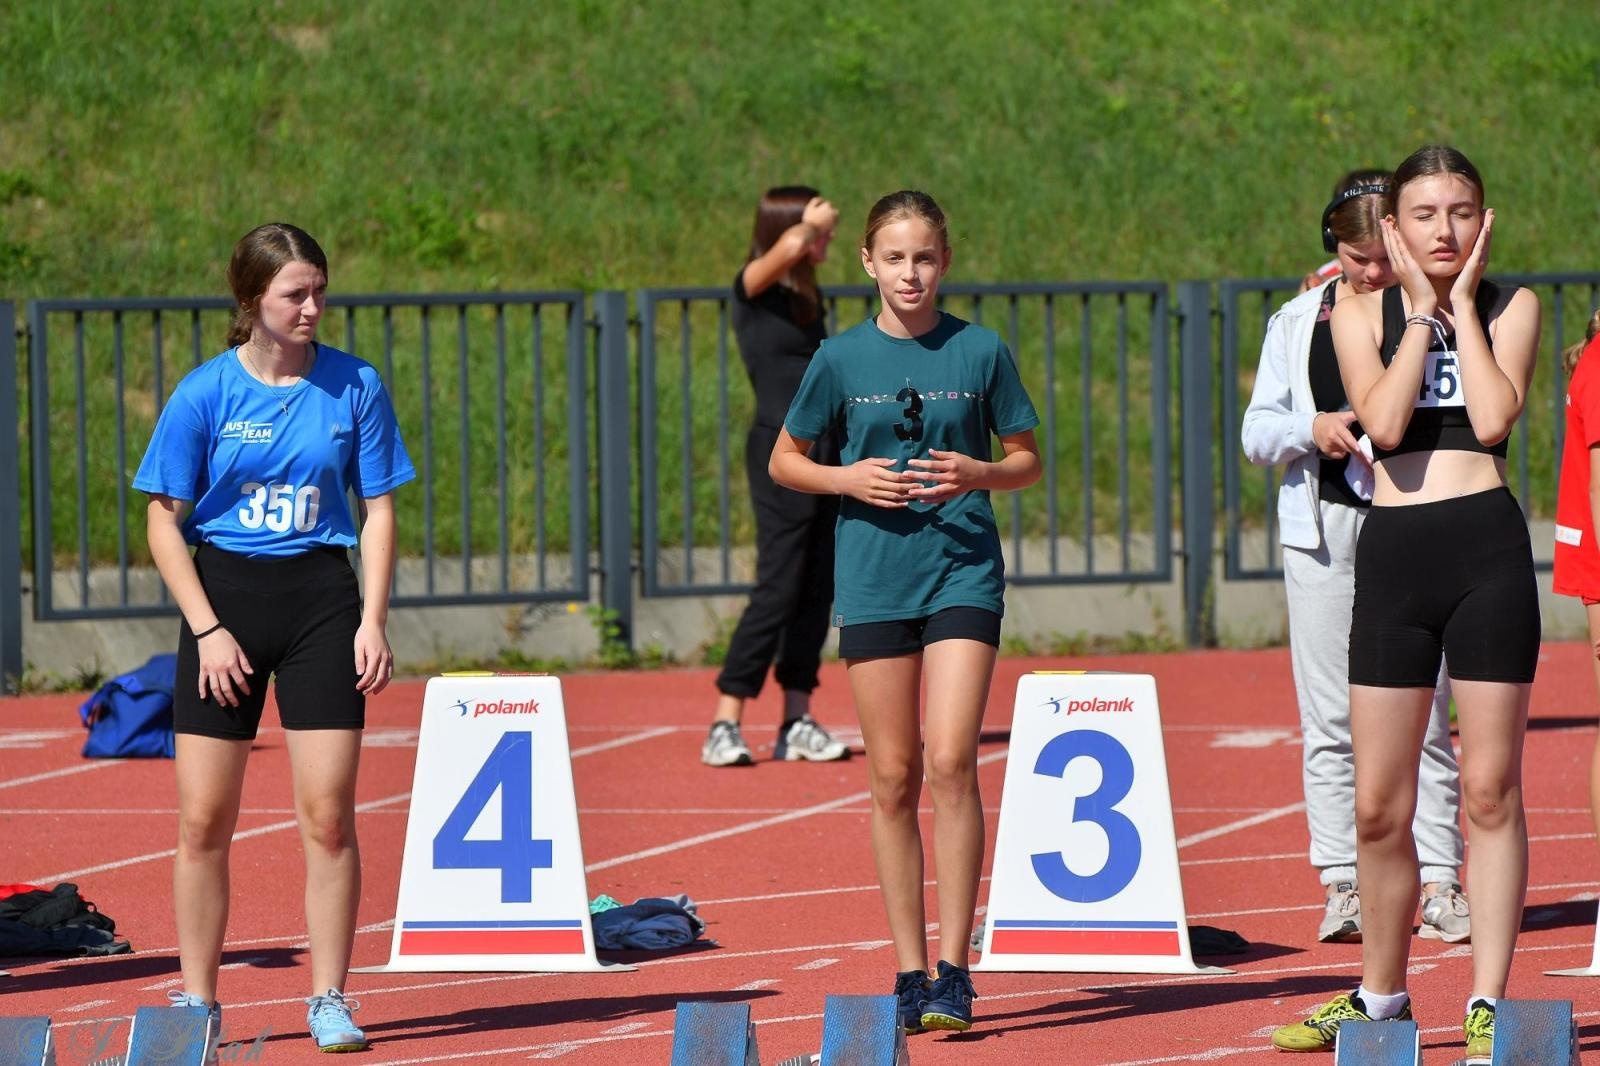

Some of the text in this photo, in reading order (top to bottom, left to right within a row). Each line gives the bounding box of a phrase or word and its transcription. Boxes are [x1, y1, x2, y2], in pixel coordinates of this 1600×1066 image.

[1343, 187, 1363, 198] KILL
[892, 387, 924, 442] 3
[223, 421, 251, 432] JUST
[242, 429, 272, 438] TEAM
[238, 482, 321, 533] 350
[473, 698, 540, 718] polanik
[1067, 696, 1134, 715] polanik
[433, 731, 552, 903] 4
[1030, 729, 1142, 903] 3
